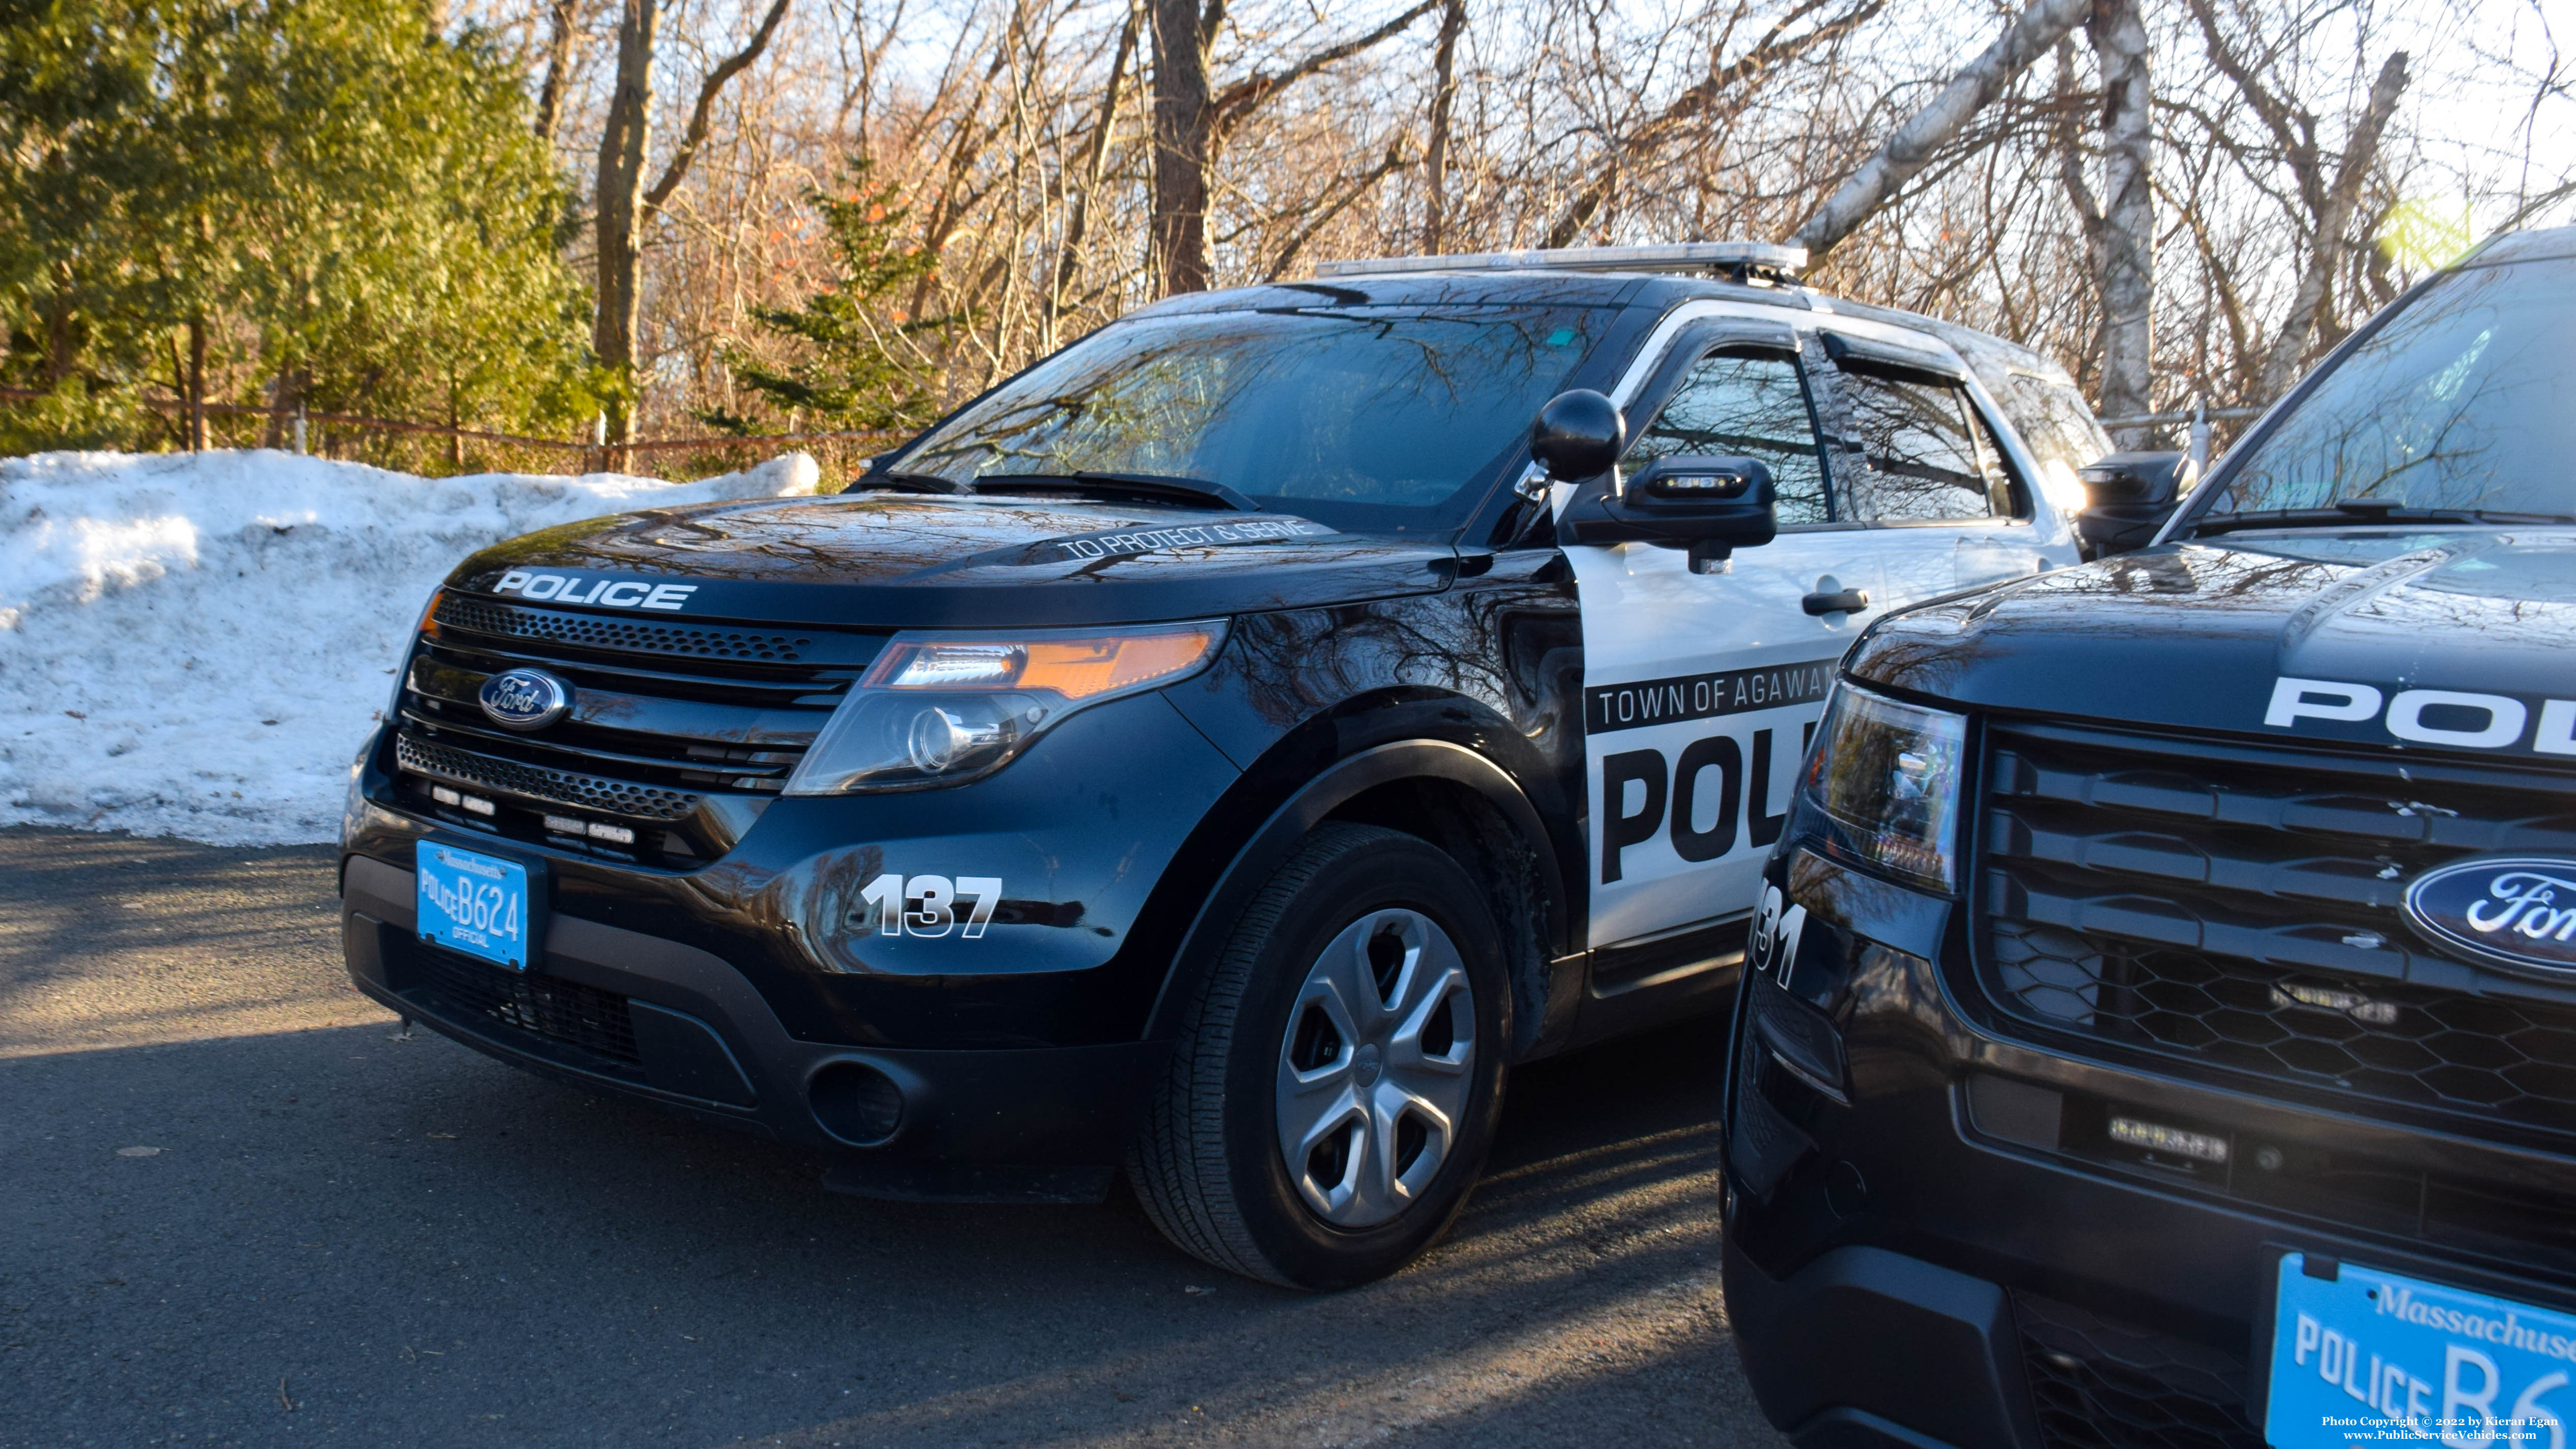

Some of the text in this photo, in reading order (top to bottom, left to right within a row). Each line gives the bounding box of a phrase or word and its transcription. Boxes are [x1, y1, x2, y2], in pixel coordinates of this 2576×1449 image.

[1058, 520, 1313, 558] TO PROTECT & SERVE
[492, 571, 698, 610] POLICE
[490, 676, 540, 712] Ford
[1599, 684, 1684, 723] TOWN
[1695, 679, 1725, 712] OF
[442, 849, 502, 880] Massachusetts
[421, 868, 519, 941] POLICE B624
[861, 874, 1002, 938] 137
[452, 926, 489, 949] OFFICIAL
[2295, 1313, 2569, 1449] POLICE B6
